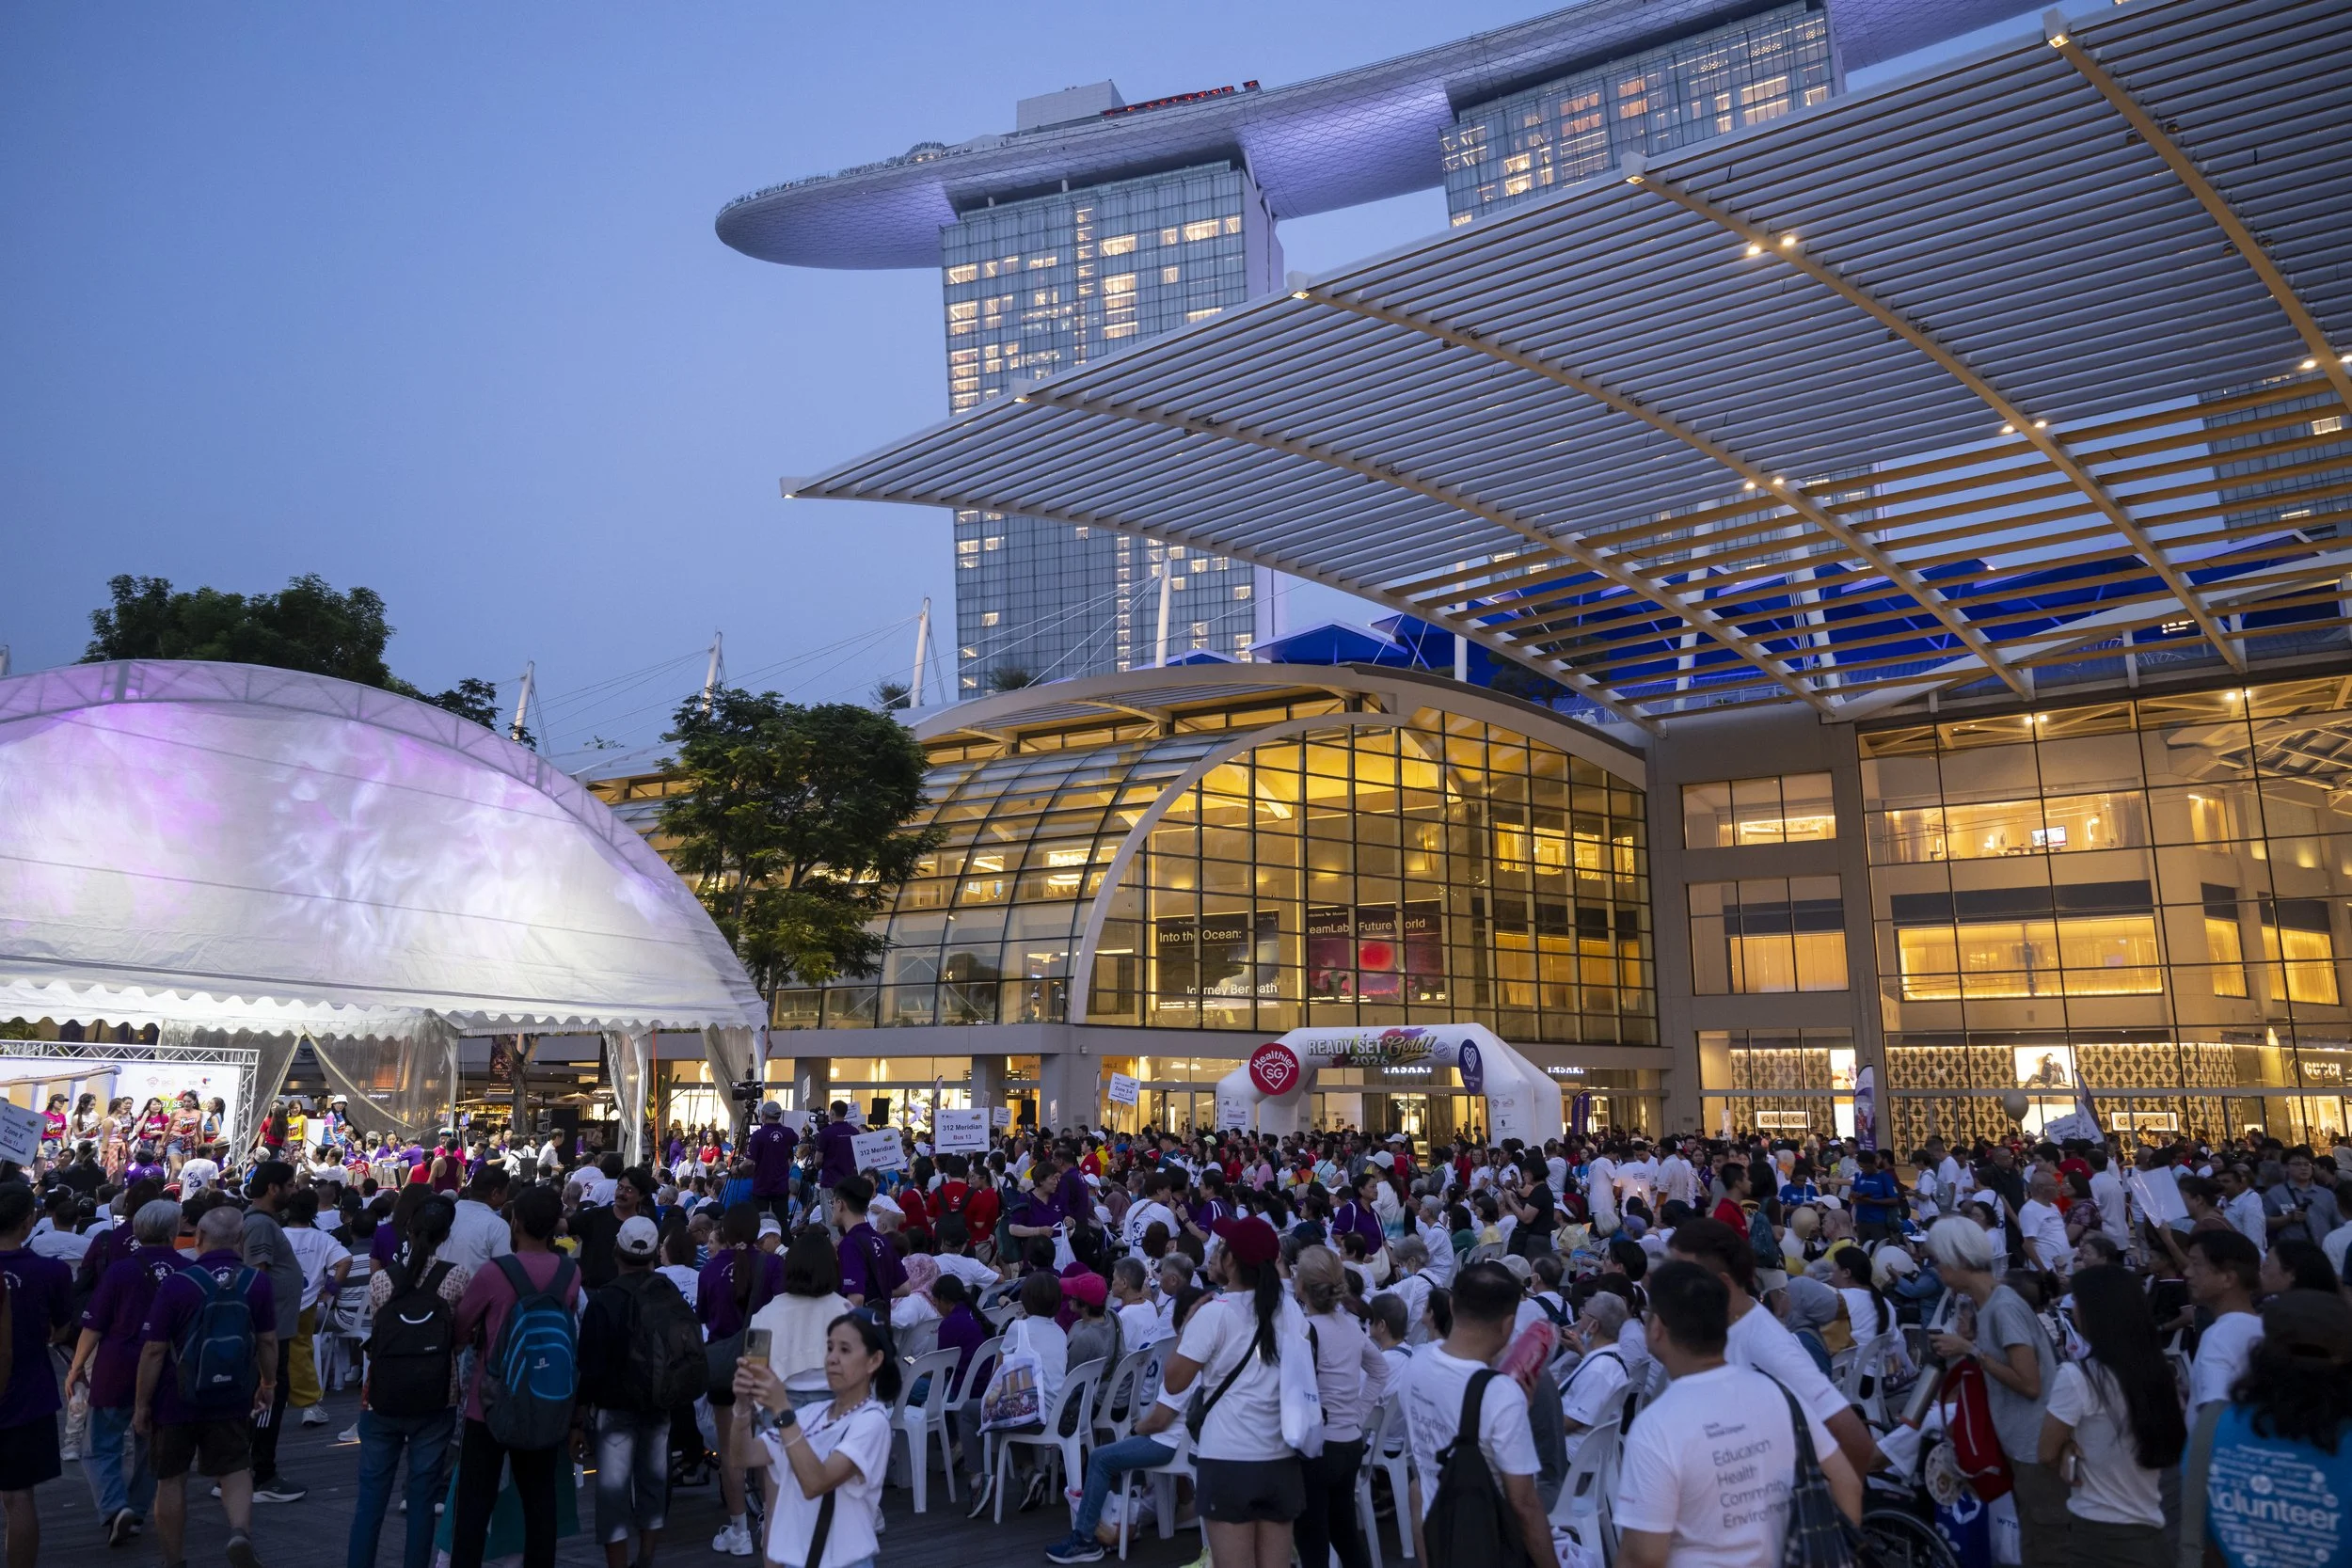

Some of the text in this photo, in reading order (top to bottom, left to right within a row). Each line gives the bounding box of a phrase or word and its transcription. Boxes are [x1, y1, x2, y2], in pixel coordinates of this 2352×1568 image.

[1309, 924, 1349, 934] eamLab
[1359, 922, 1392, 931] Future
[1159, 929, 1242, 942] Into th Ocean:
[1308, 1038, 1353, 1055] READY
[1357, 1038, 1383, 1055] SET
[1385, 1035, 1438, 1056] Gold!
[1252, 1050, 1296, 1070] Healthier
[1350, 1055, 1390, 1066] 2026
[1265, 1068, 1284, 1079] SG
[1761, 1116, 1805, 1124] GUCCI
[2118, 1117, 2166, 1126] GUCC
[4, 1125, 19, 1137] Zone
[3, 1135, 12, 1145] Bus
[860, 1144, 896, 1157] 312 Meridian
[2206, 1483, 2342, 1532] Volunteer
